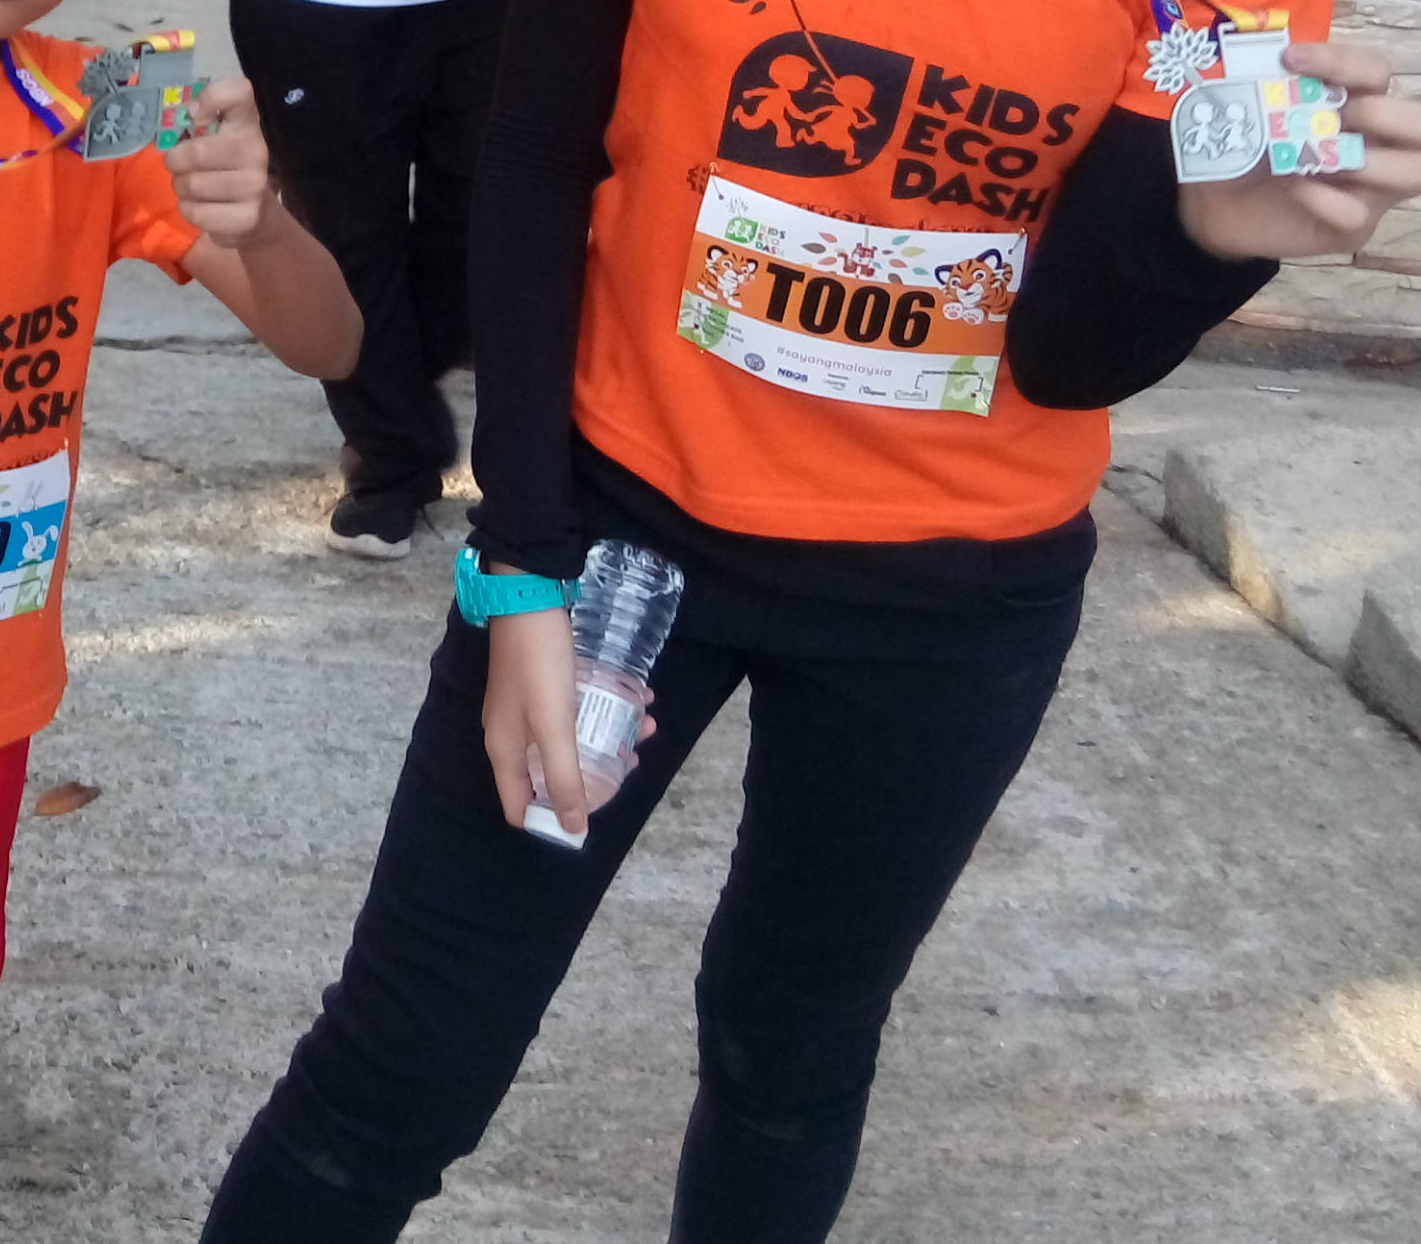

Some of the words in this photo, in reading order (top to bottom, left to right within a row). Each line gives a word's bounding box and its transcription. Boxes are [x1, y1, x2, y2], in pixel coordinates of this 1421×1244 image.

[917, 64, 1080, 146] KIDS
[902, 113, 1039, 179] ECO
[891, 159, 1051, 223] DASH
[766, 262, 936, 349] T006
[776, 346, 893, 377] #sayangmalaysia
